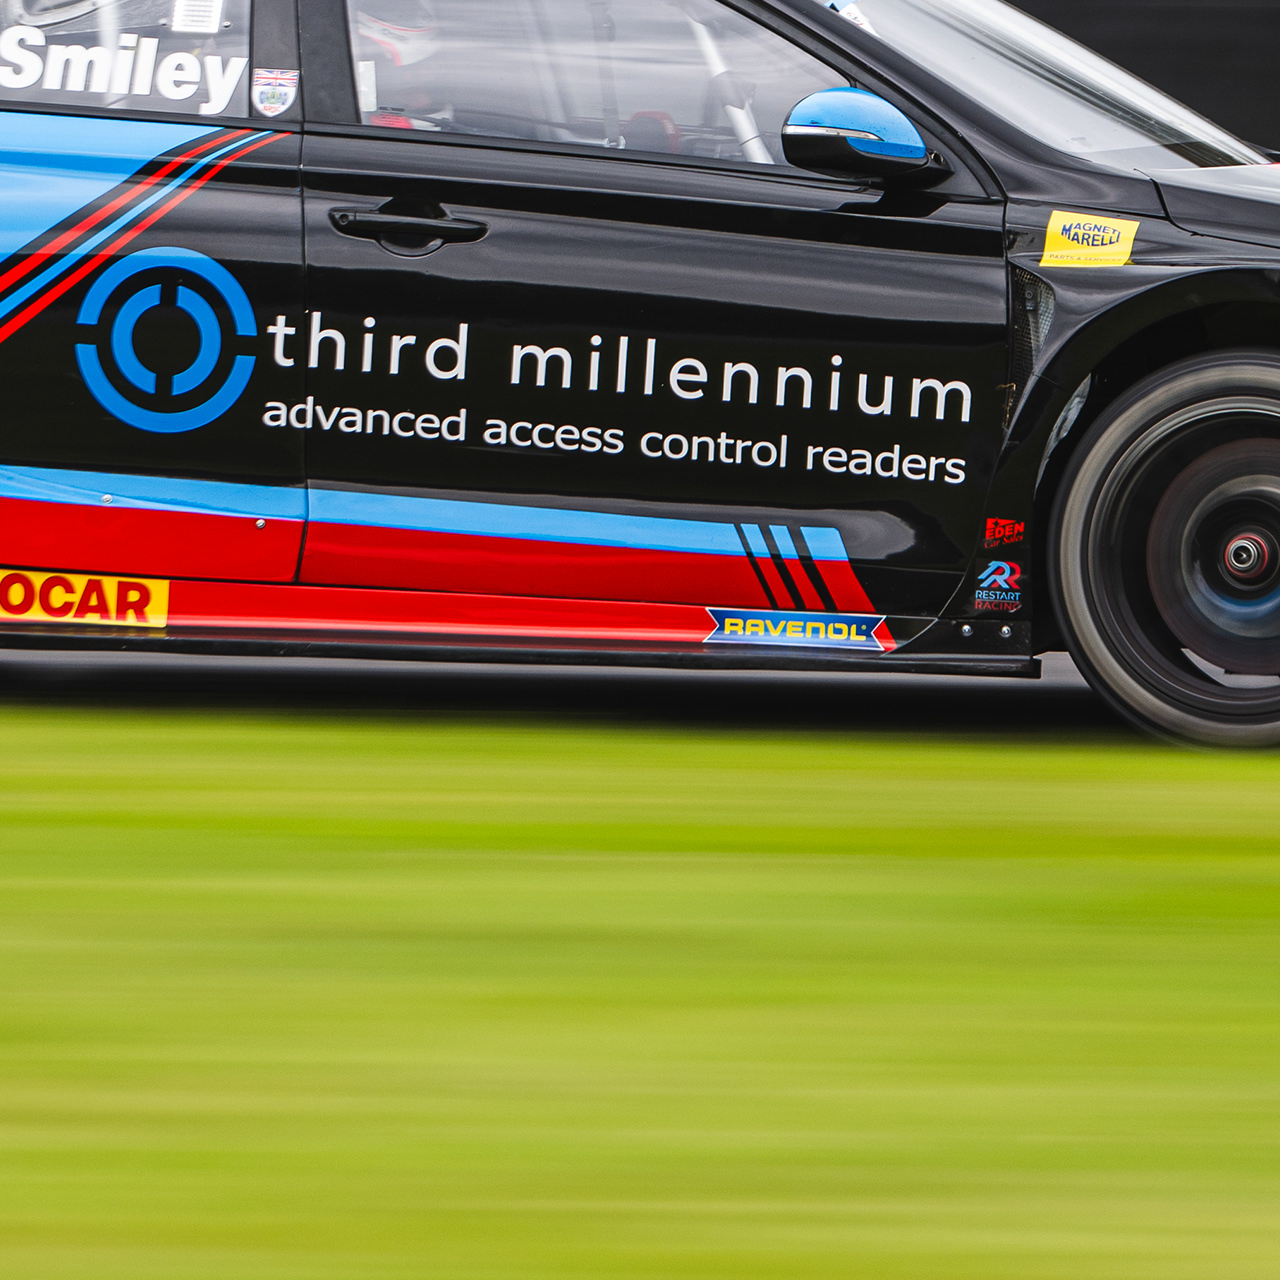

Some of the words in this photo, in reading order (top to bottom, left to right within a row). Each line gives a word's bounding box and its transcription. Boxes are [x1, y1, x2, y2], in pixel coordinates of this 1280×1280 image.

[266, 312, 468, 379] third
[510, 335, 972, 422] millennium
[262, 396, 467, 441] advanced
[483, 418, 625, 454] access
[640, 431, 788, 467] control
[806, 444, 966, 484] readers
[985, 522, 1025, 540] EDEN
[975, 590, 1021, 601] RESTART
[975, 600, 1022, 611] RACING
[724, 618, 867, 641] RAVENOL
